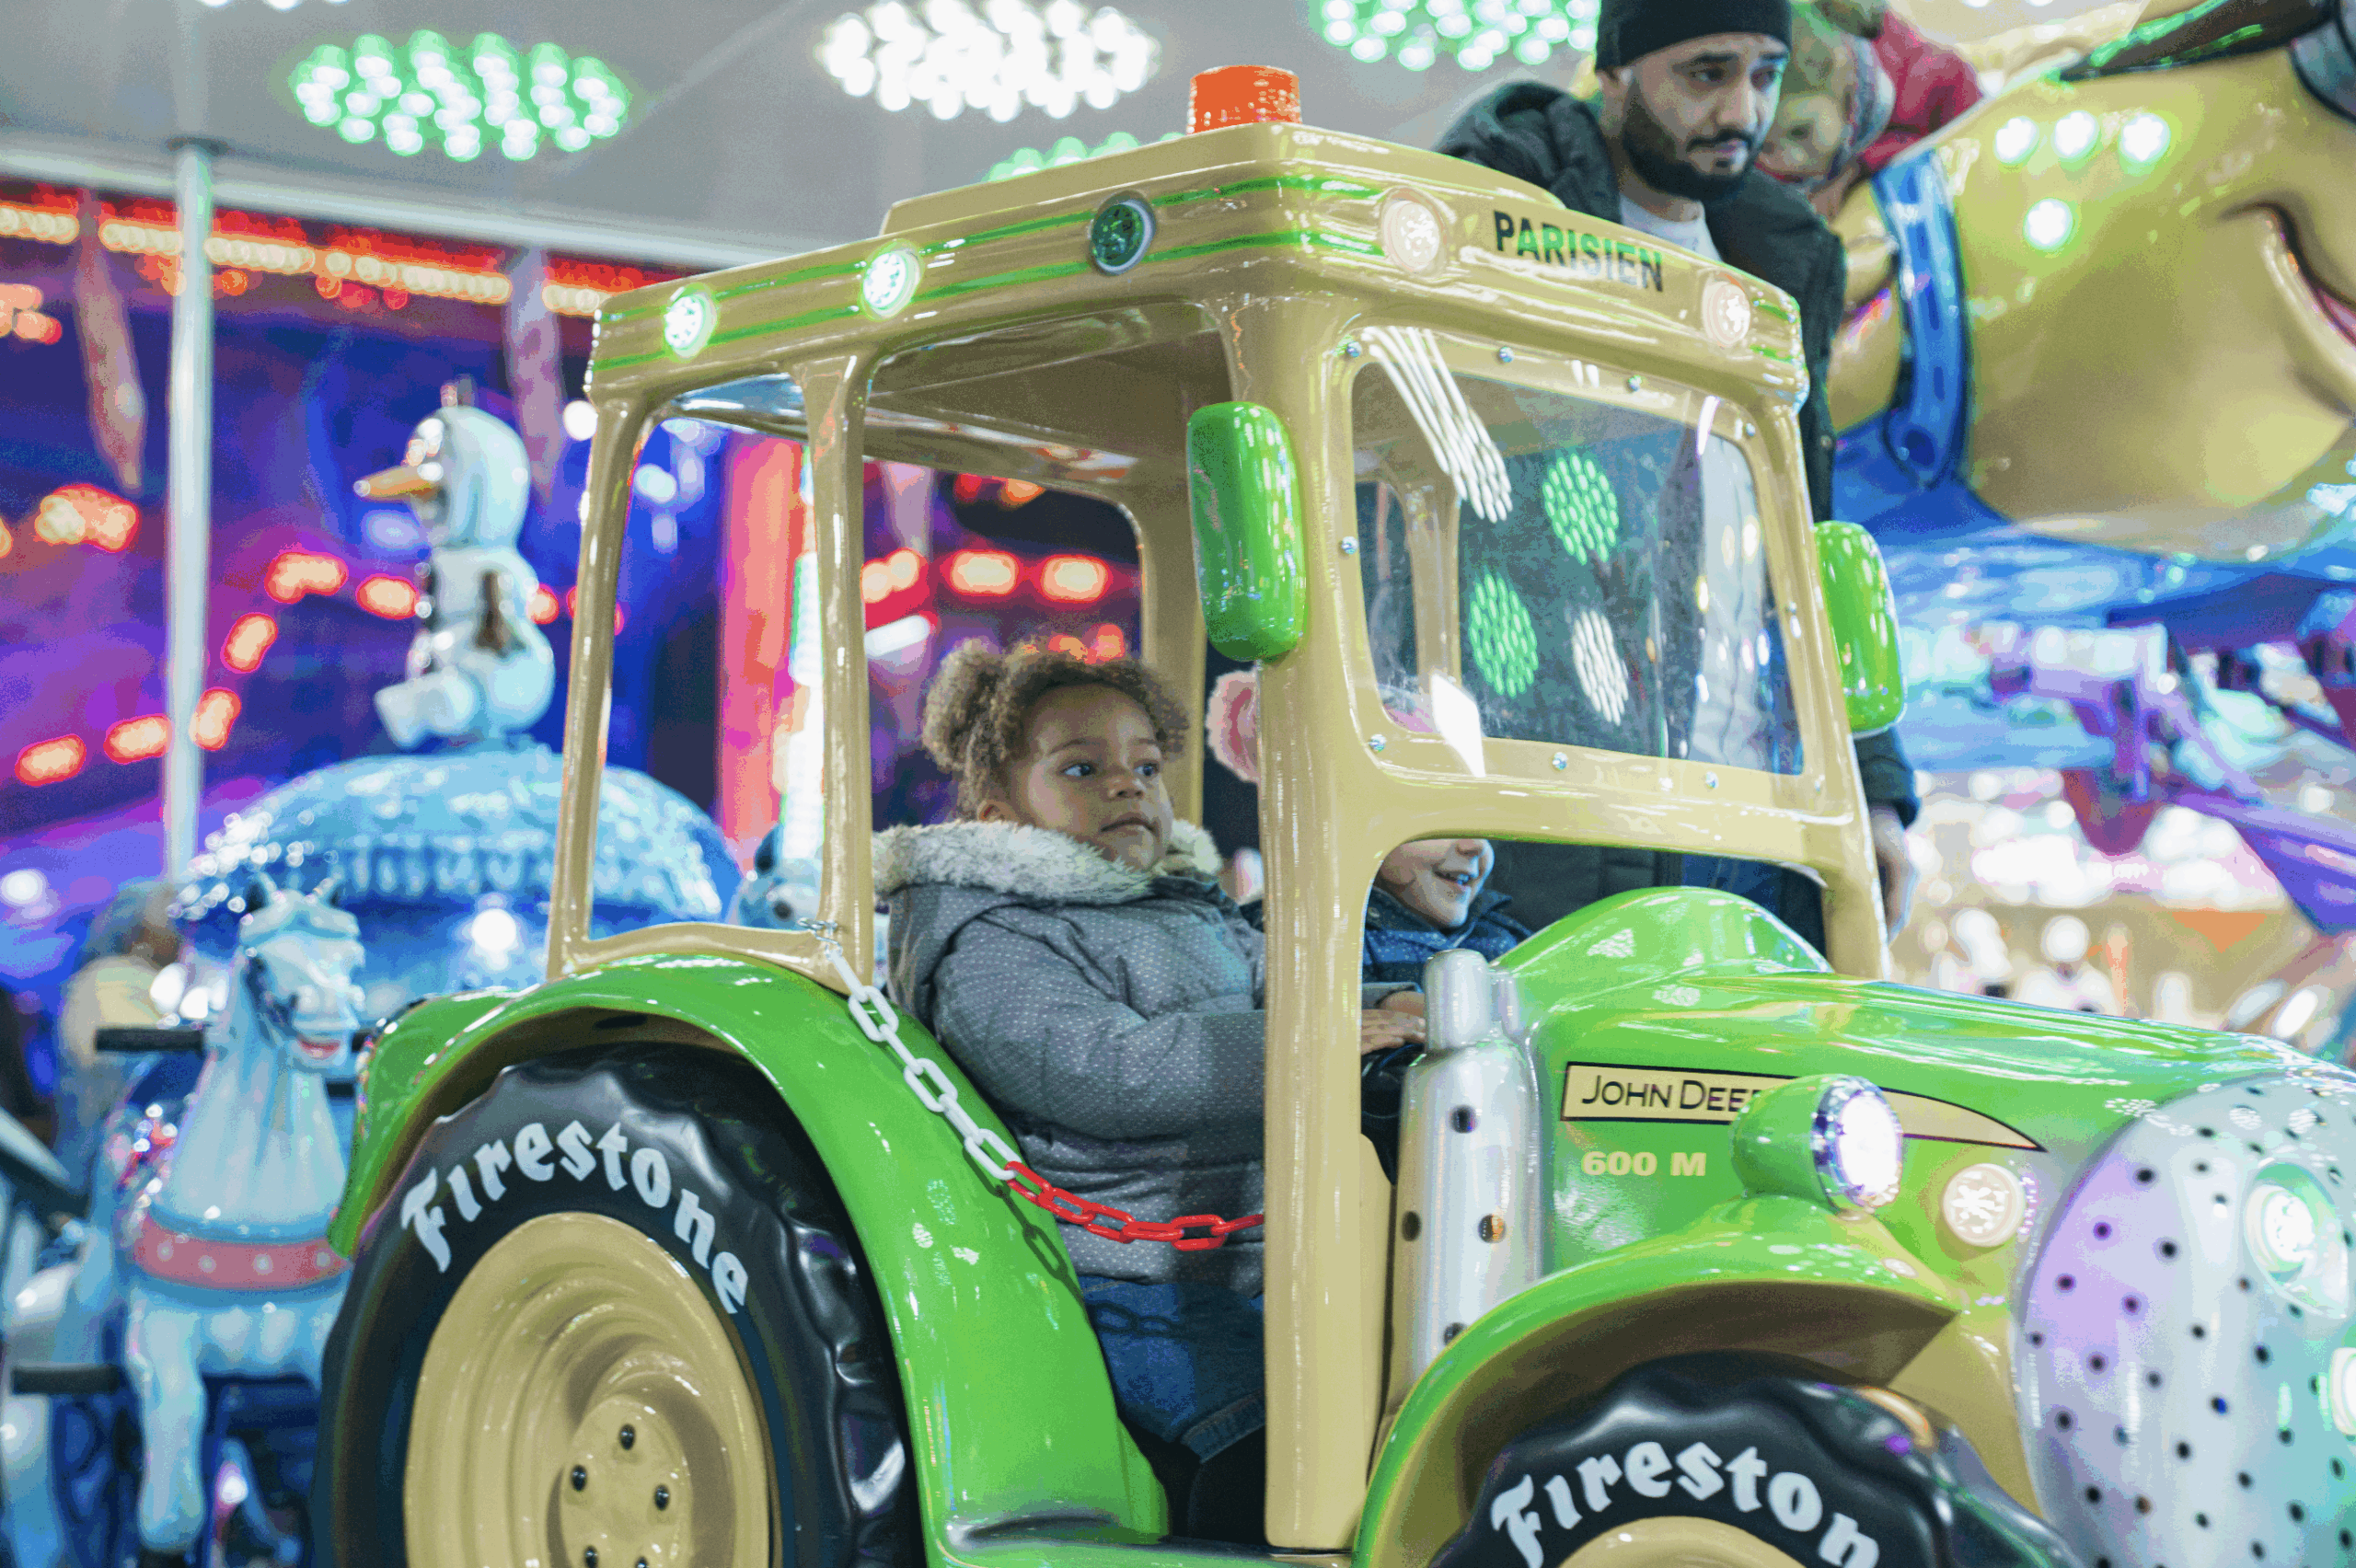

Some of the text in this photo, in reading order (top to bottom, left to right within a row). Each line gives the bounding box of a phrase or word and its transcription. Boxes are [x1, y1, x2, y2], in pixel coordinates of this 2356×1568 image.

[1494, 210, 1663, 292] PARISIEN
[1581, 1075, 1761, 1113] JOHN DEE
[1582, 1151, 1707, 1176] 600 M
[401, 1120, 748, 1314] Firestone
